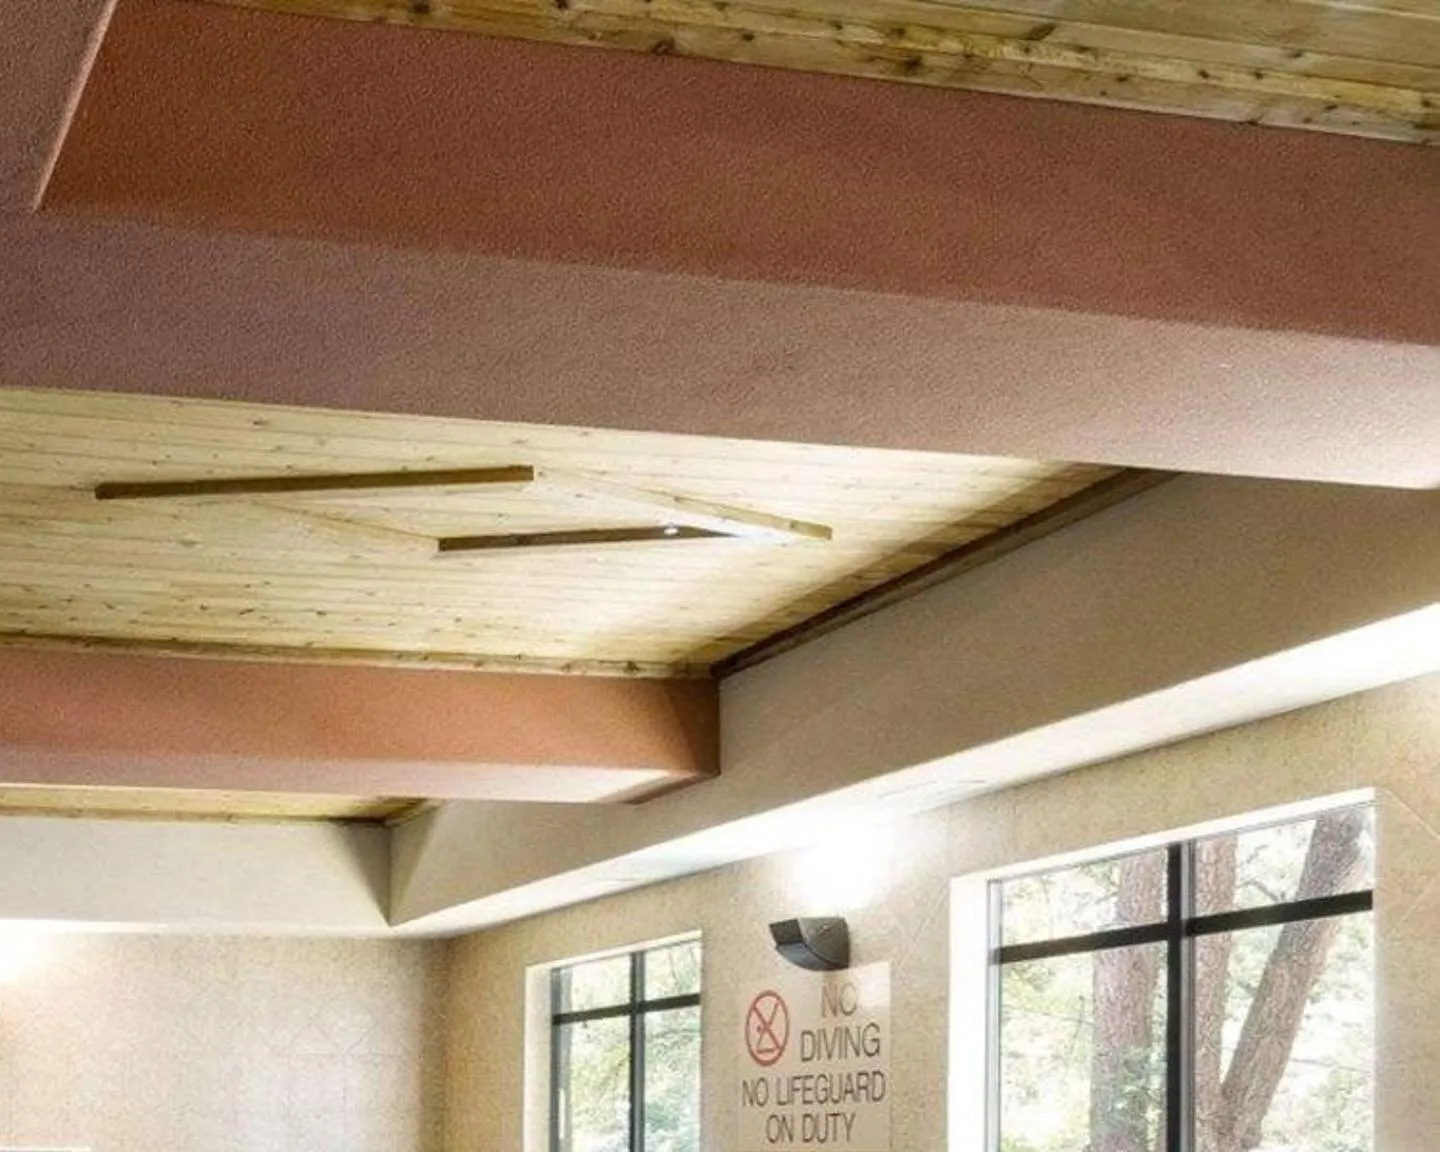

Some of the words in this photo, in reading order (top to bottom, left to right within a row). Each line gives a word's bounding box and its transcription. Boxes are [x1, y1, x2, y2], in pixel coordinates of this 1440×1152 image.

[820, 982, 859, 1019] NO
[799, 1022, 881, 1063] DIVING
[742, 1076, 769, 1107] NO
[776, 1070, 886, 1105] LIFEGUARD
[765, 1114, 795, 1144] ON
[801, 1111, 856, 1144] DUTY
